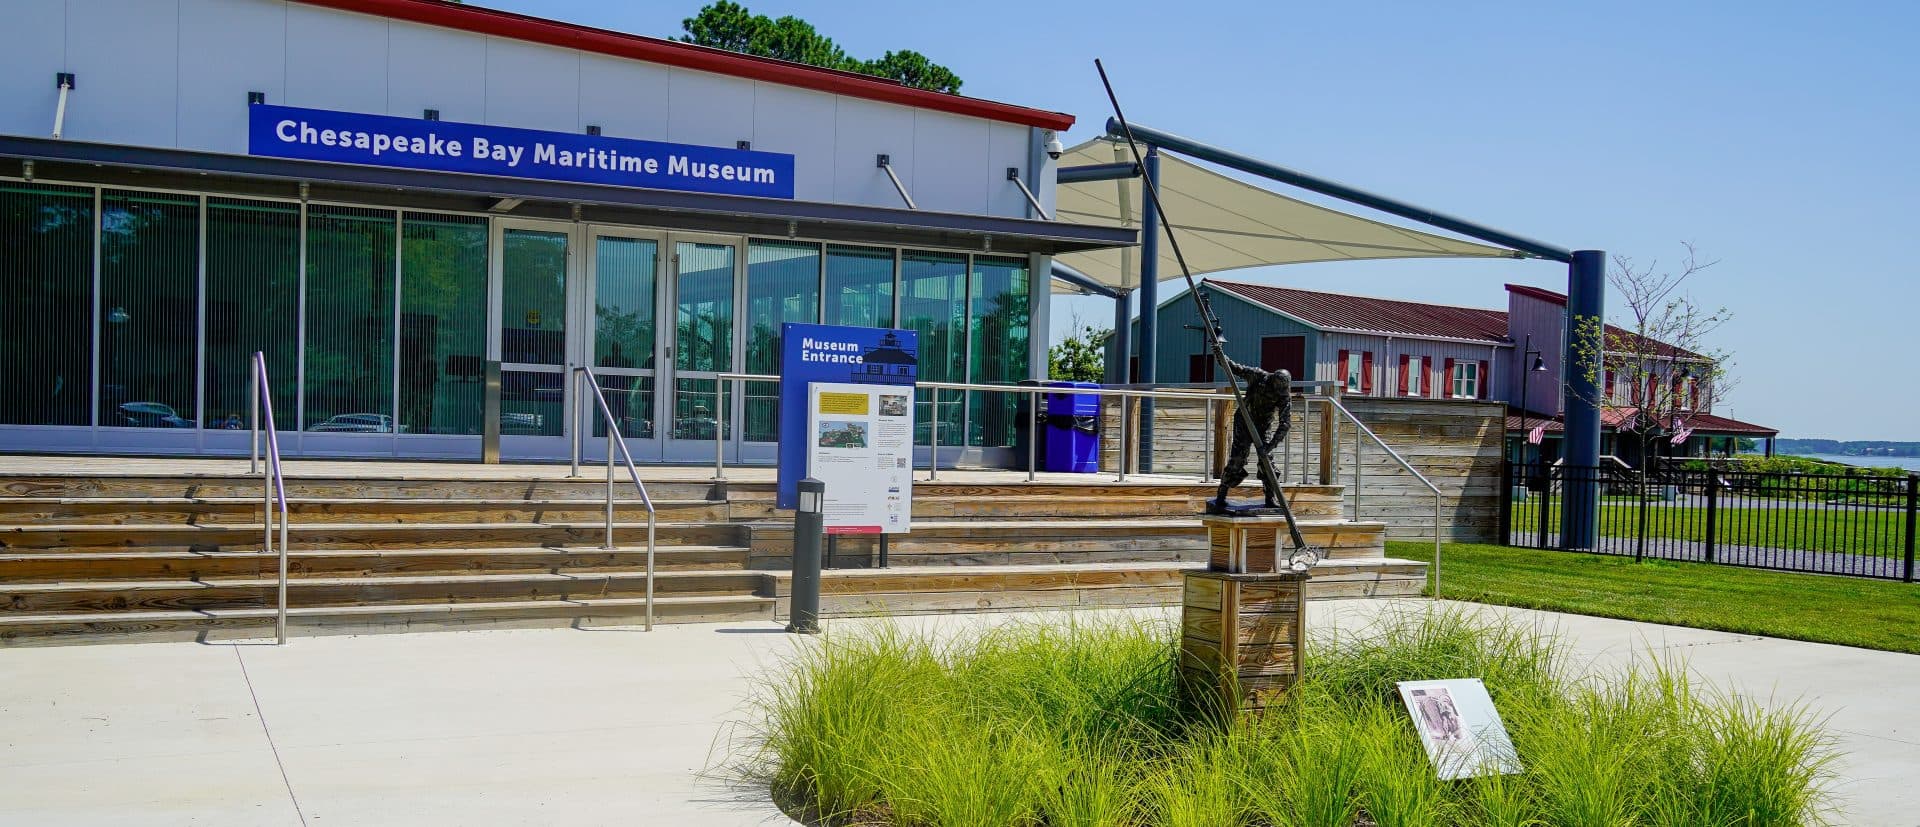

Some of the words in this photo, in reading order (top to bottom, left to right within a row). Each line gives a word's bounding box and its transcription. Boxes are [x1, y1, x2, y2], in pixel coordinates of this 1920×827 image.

[276, 119, 462, 157] Chesapeake
[473, 137, 524, 167] Bay
[533, 142, 659, 174] Maritime
[667, 155, 775, 184] Museum
[802, 337, 859, 352] Museum
[802, 349, 864, 364] Entrance
